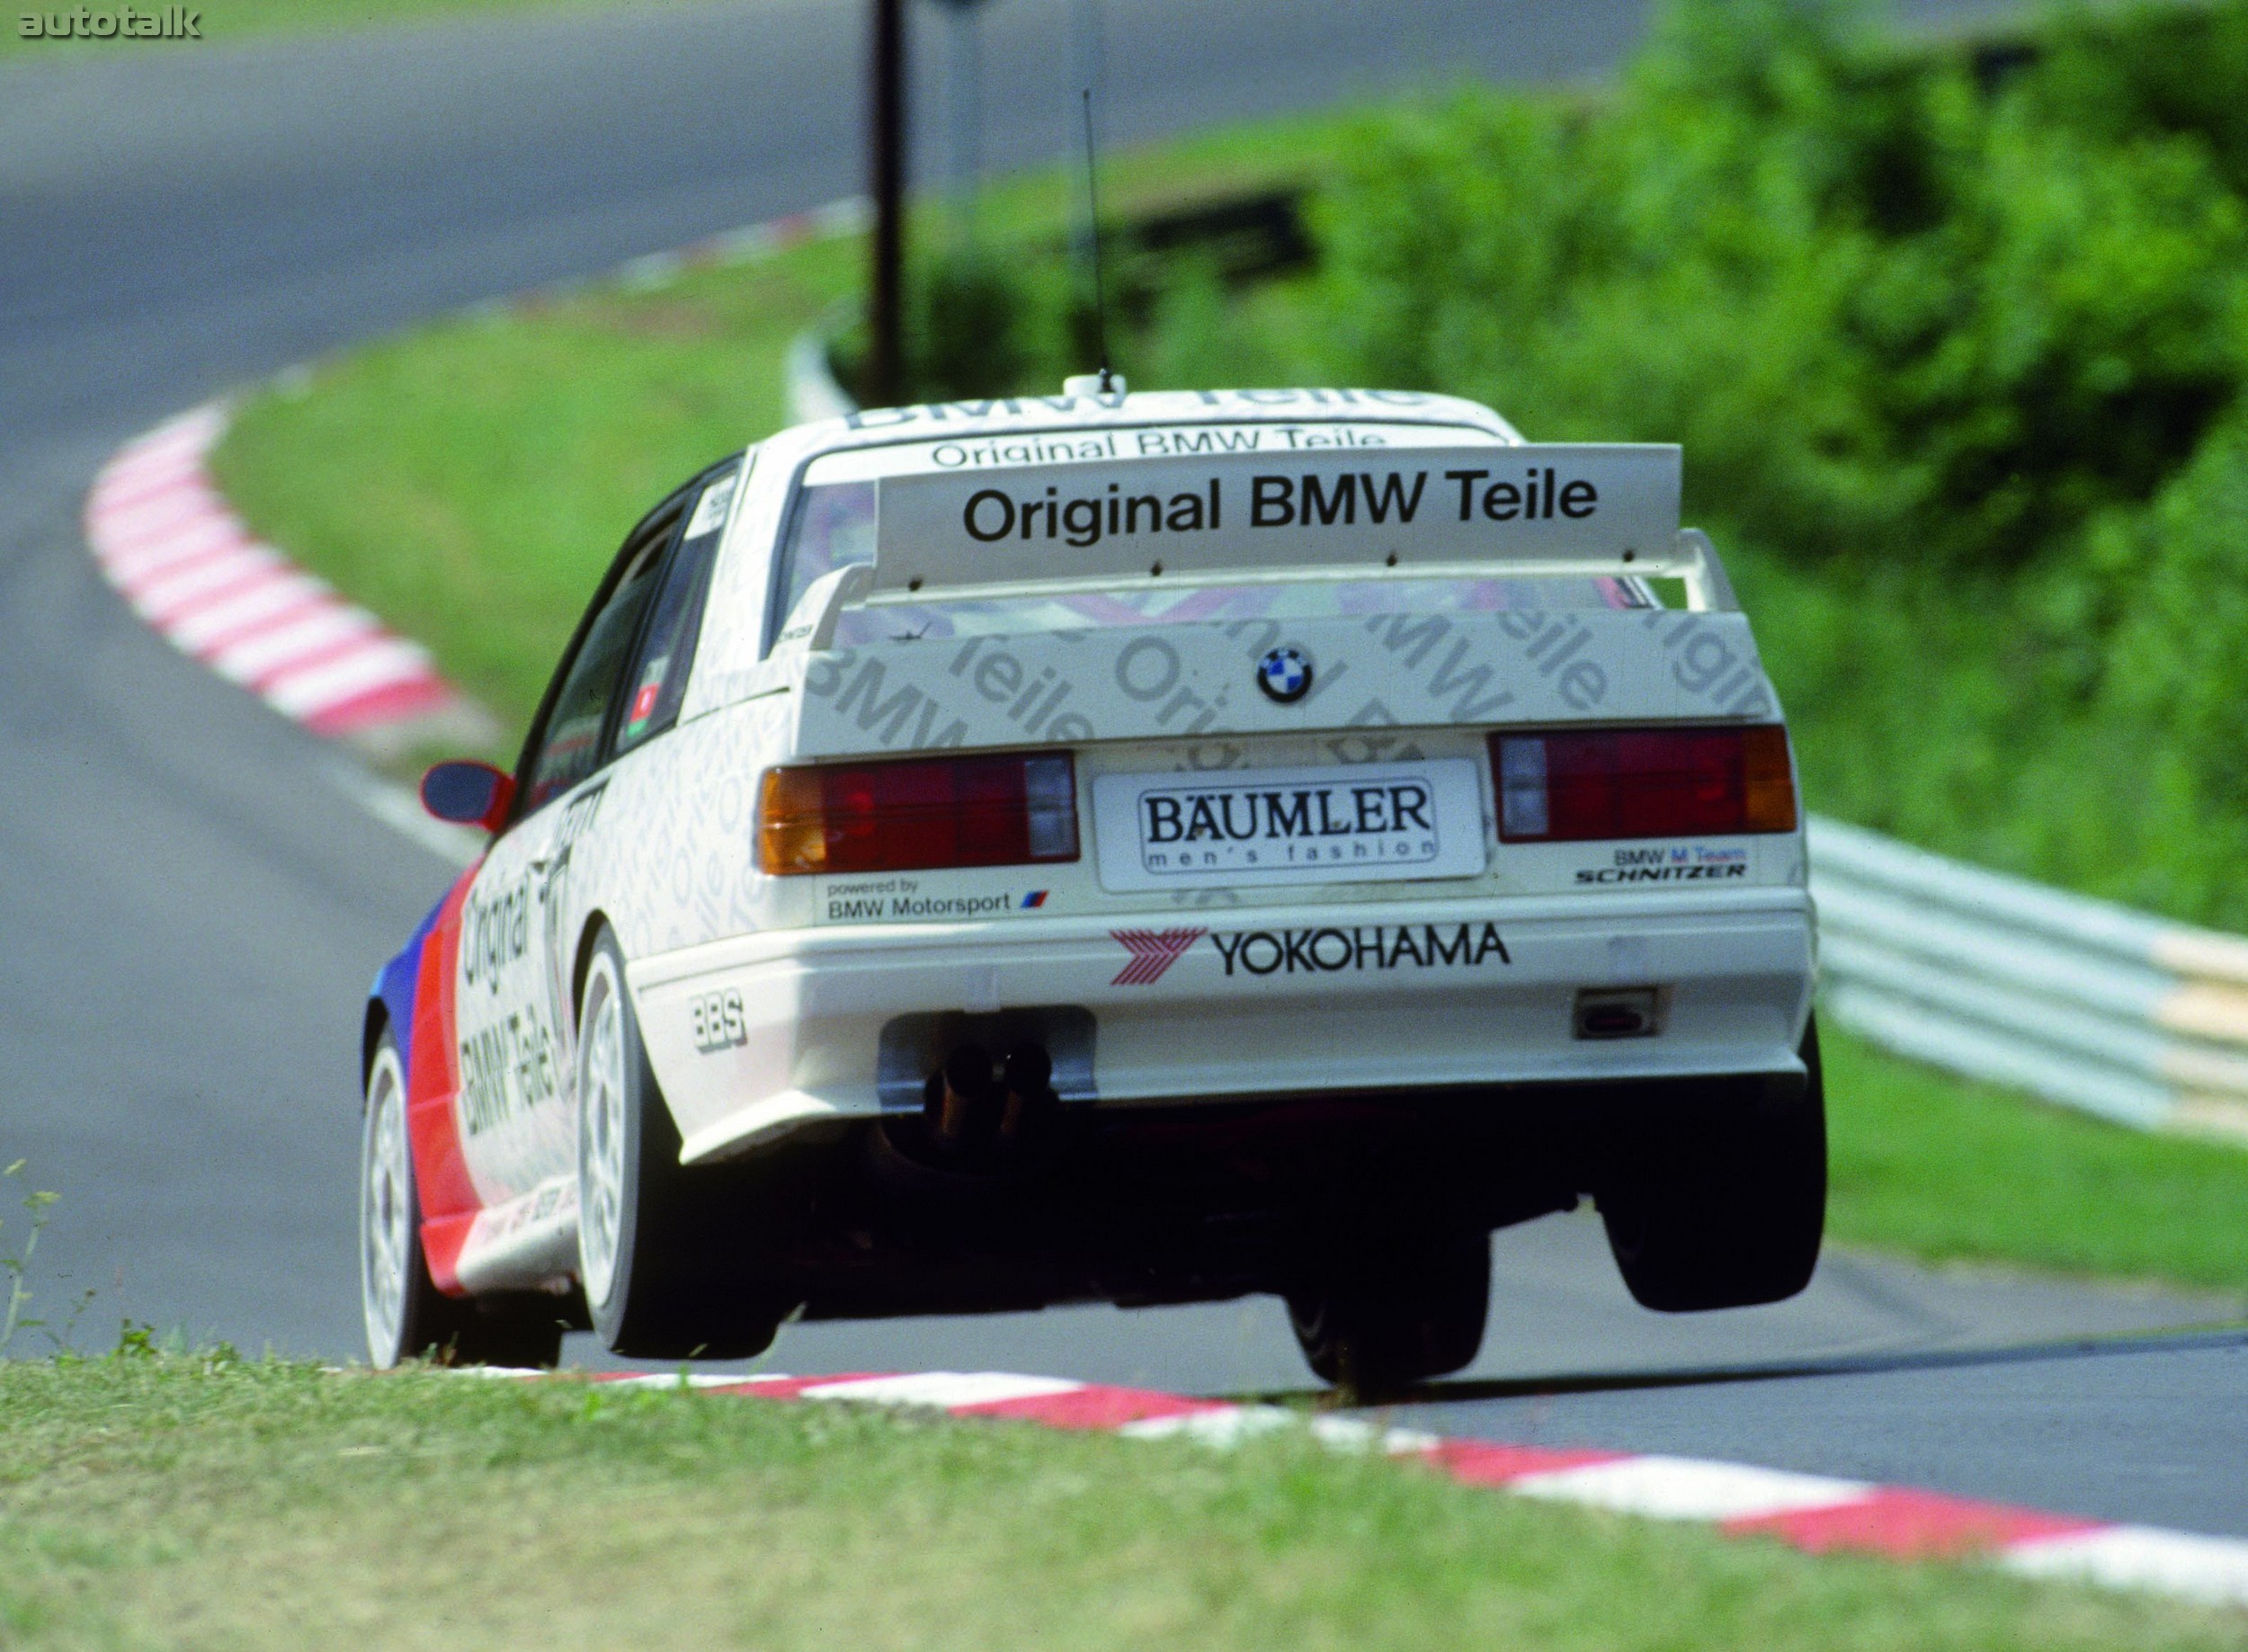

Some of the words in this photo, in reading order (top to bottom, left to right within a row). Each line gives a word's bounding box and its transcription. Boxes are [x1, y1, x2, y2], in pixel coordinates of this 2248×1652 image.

[932, 435, 1117, 468] Original
[1137, 429, 1260, 455] BMW
[963, 478, 1221, 547] Original
[1251, 471, 1428, 527] BMW
[1445, 469, 1598, 522] Teile
[1145, 785, 1432, 844] BÄUMLER
[1148, 846, 1258, 867] men's
[1287, 839, 1436, 862] fashion
[1615, 848, 1664, 864] BMW
[827, 879, 896, 897] powered
[900, 878, 919, 894] by
[1575, 863, 1747, 883] SCHNITZER
[828, 897, 883, 920] BMW
[892, 893, 1011, 917] Motorsport
[1211, 922, 1511, 976] YOKOHAMA
[690, 987, 748, 1054] BBS
